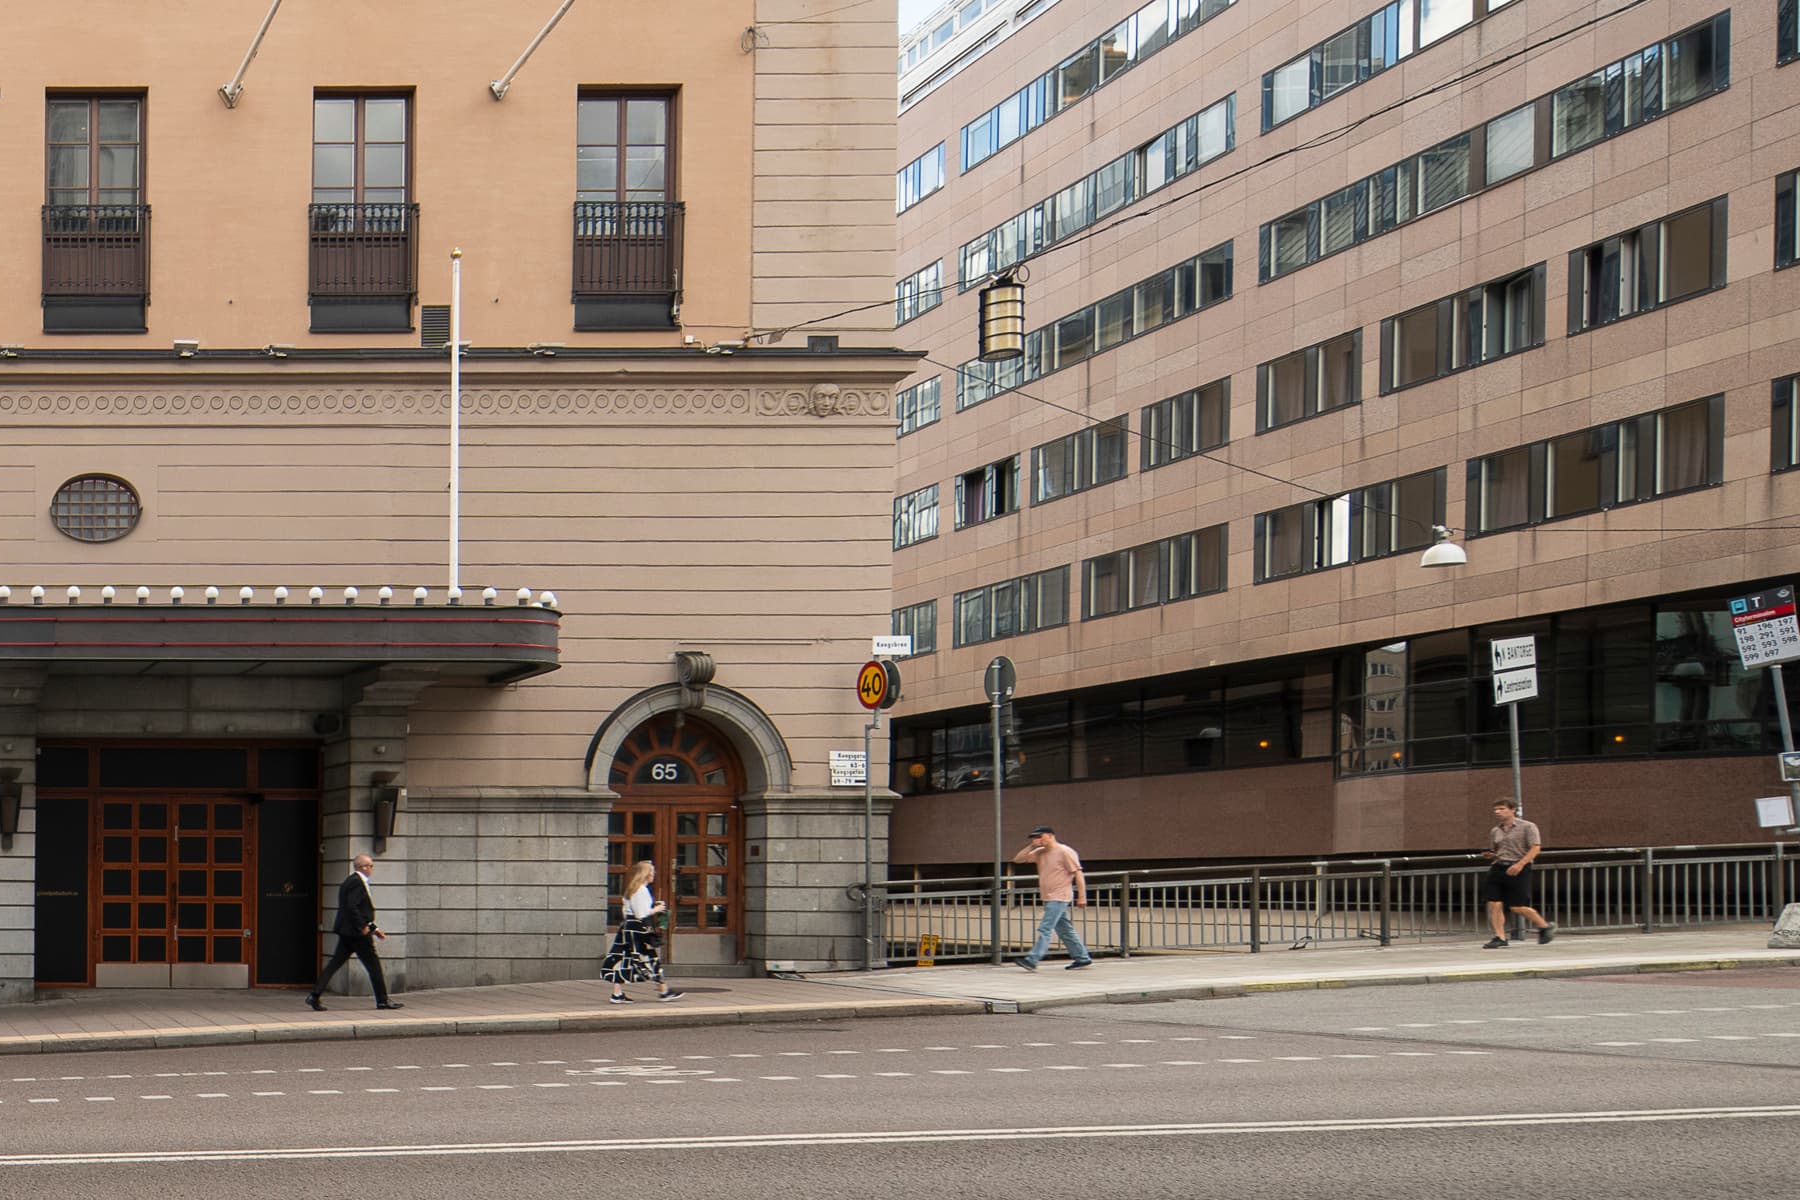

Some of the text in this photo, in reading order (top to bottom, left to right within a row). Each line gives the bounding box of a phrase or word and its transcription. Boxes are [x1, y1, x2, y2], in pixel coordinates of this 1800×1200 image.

[1757, 622, 1774, 631] 196
[1778, 618, 1793, 626] 197
[1739, 627, 1795, 644] 198 291 591
[1742, 636, 1797, 653] 592 593 598
[1744, 649, 1779, 661] 599 697
[862, 673, 882, 697] 40
[651, 763, 678, 780] 65
